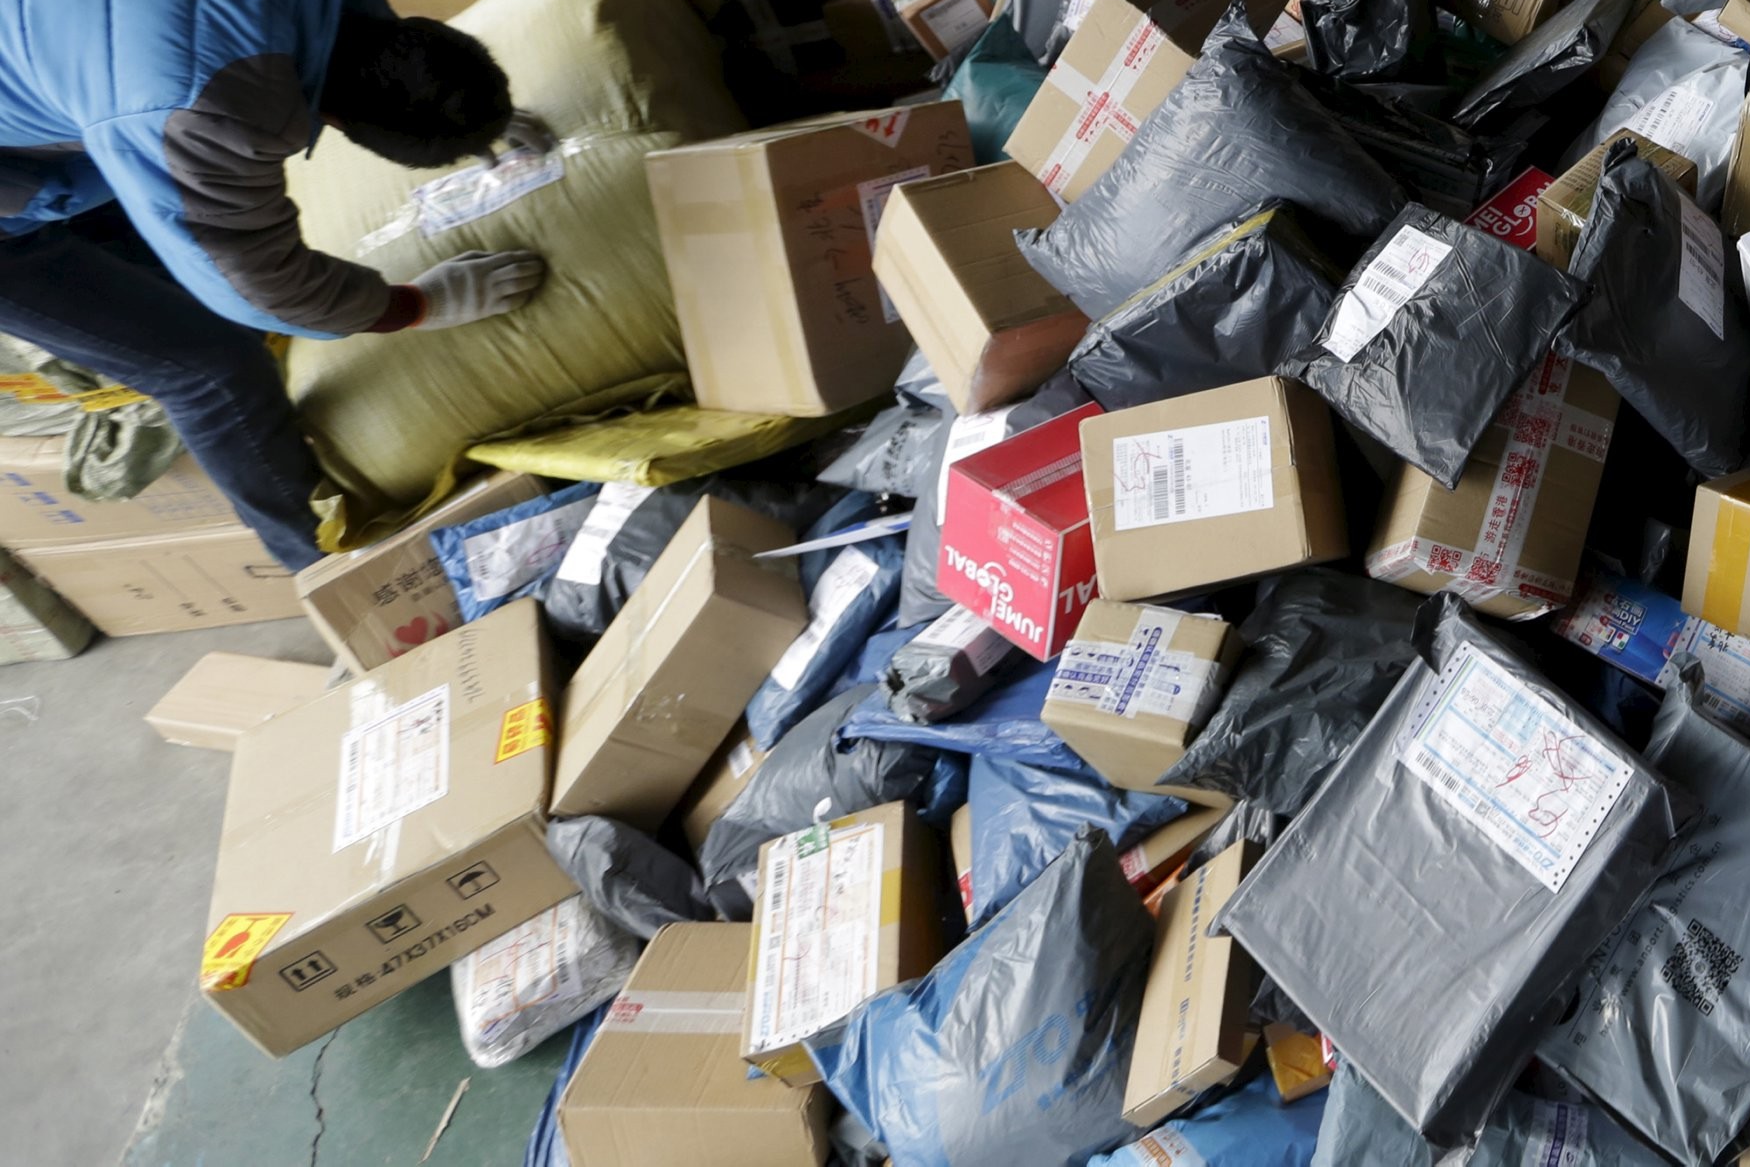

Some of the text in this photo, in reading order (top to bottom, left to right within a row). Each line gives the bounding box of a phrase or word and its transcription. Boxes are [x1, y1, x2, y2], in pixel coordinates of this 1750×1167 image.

[1483, 495, 1509, 543] 游走香港
[943, 546, 1015, 606] GLOBAL
[986, 595, 1044, 643] JUMEI
